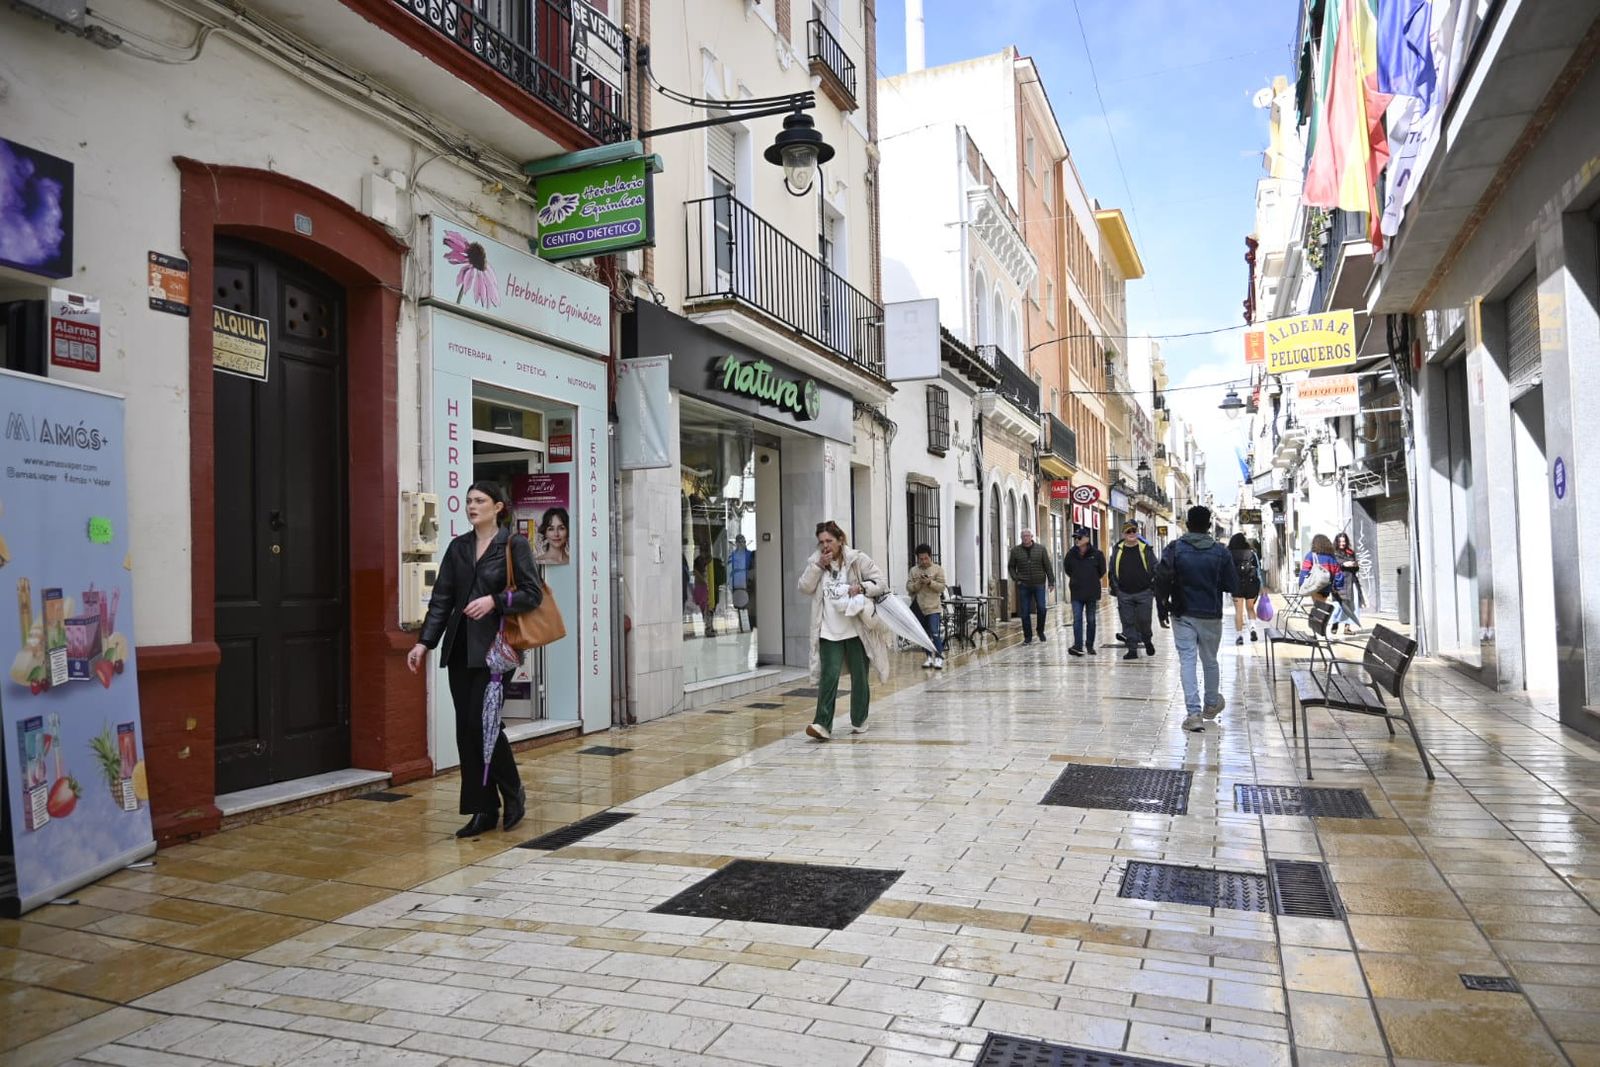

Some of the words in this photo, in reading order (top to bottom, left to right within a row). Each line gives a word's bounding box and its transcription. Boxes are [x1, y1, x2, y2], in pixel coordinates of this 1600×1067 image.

[574, 0, 589, 27] SE
[589, 13, 625, 57] VENDE
[581, 175, 644, 200] Herbolario
[580, 193, 645, 222] Equinácea
[546, 231, 584, 246] CENTRO
[587, 222, 637, 239] DIETETICO
[505, 272, 557, 310] Herbolario
[558, 295, 603, 327] Equinácea
[55, 320, 97, 338] Alarma
[213, 310, 267, 343] ALQUILA
[1268, 318, 1350, 346] ALDEMAR
[448, 342, 493, 362] FITOTERAPIA
[516, 361, 547, 377] DIETÉTICA
[1271, 342, 1351, 368] PELUQUEROS
[589, 427, 599, 538] TERAPIAS
[590, 551, 600, 676] NATURALES
